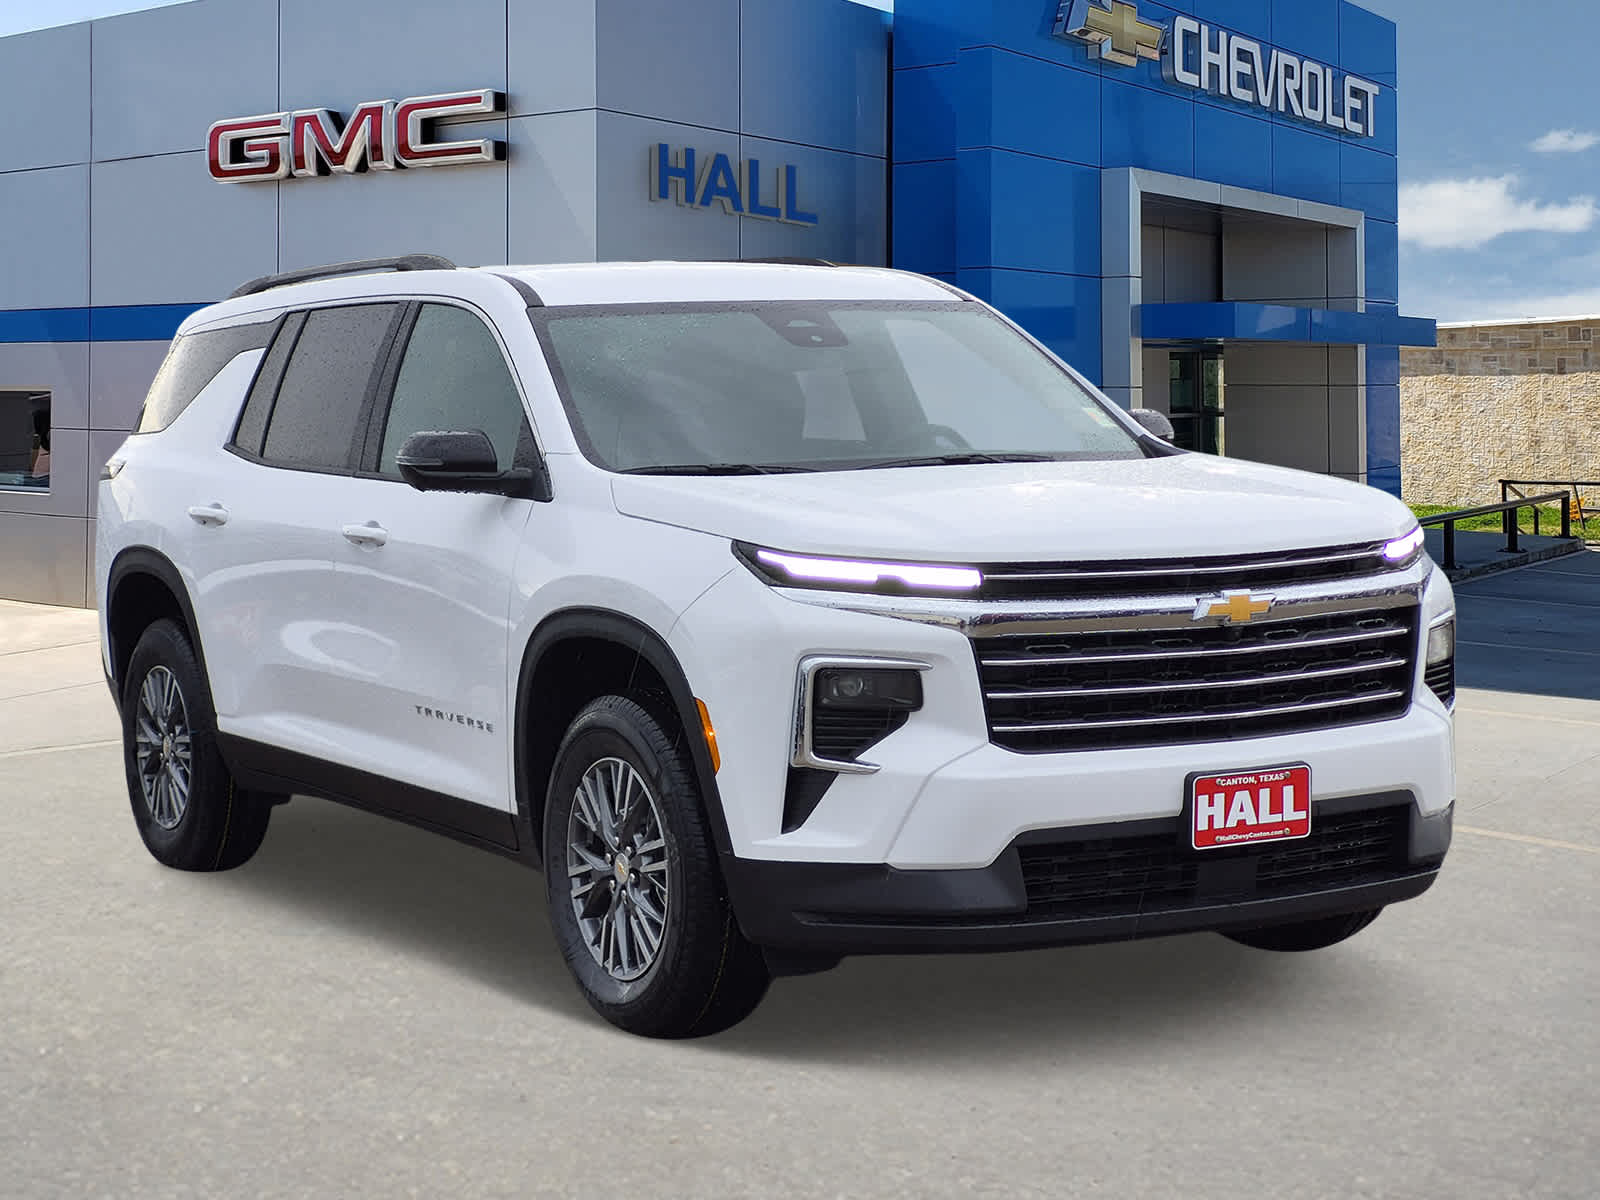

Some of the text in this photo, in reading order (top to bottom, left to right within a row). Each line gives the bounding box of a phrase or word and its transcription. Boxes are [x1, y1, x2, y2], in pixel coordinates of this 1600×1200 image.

[1173, 15, 1379, 137] CHEVROLET
[208, 89, 505, 184] GMC
[651, 143, 818, 227] HALL
[415, 705, 493, 733] TRAVERSE
[1197, 785, 1307, 831] HALL
[1221, 774, 1285, 786] CANTON, TEXAS
